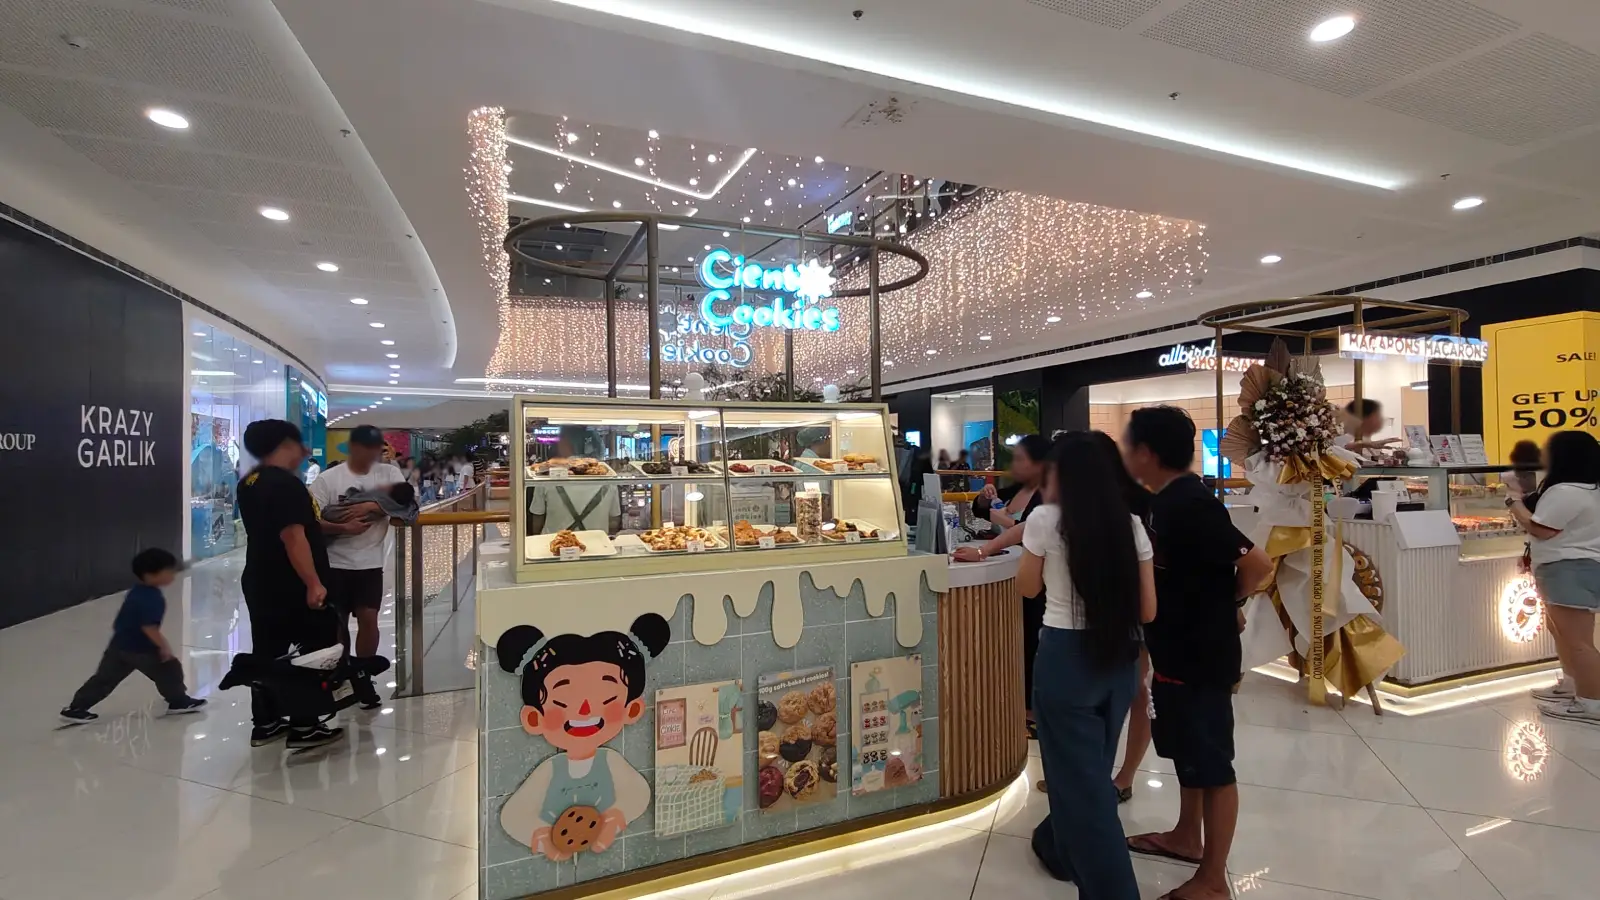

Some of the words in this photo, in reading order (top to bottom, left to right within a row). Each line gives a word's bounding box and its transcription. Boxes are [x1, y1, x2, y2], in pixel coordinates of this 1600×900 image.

[700, 288, 840, 333] Cookies
[1159, 339, 1217, 367] allbird
[1350, 334, 1420, 355] MACARONS
[1425, 341, 1489, 360] MACARONS
[1556, 352, 1596, 363] SALE!
[1512, 391, 1565, 405] GET
[1575, 389, 1599, 402] UP
[80, 404, 154, 437] KRAZY
[1512, 406, 1598, 429] 50%
[77, 438, 156, 469] GARLIK
[1313, 501, 1323, 527] BRANCH
[1313, 530, 1323, 545] MOA
[1313, 548, 1323, 570] YOUR
[1313, 570, 1323, 601] OPENING
[1313, 602, 1323, 613] ON
[1313, 615, 1323, 680] CONGRATULATIONS
[773, 677, 806, 692] soft-baked
[806, 671, 829, 682] cookies!
